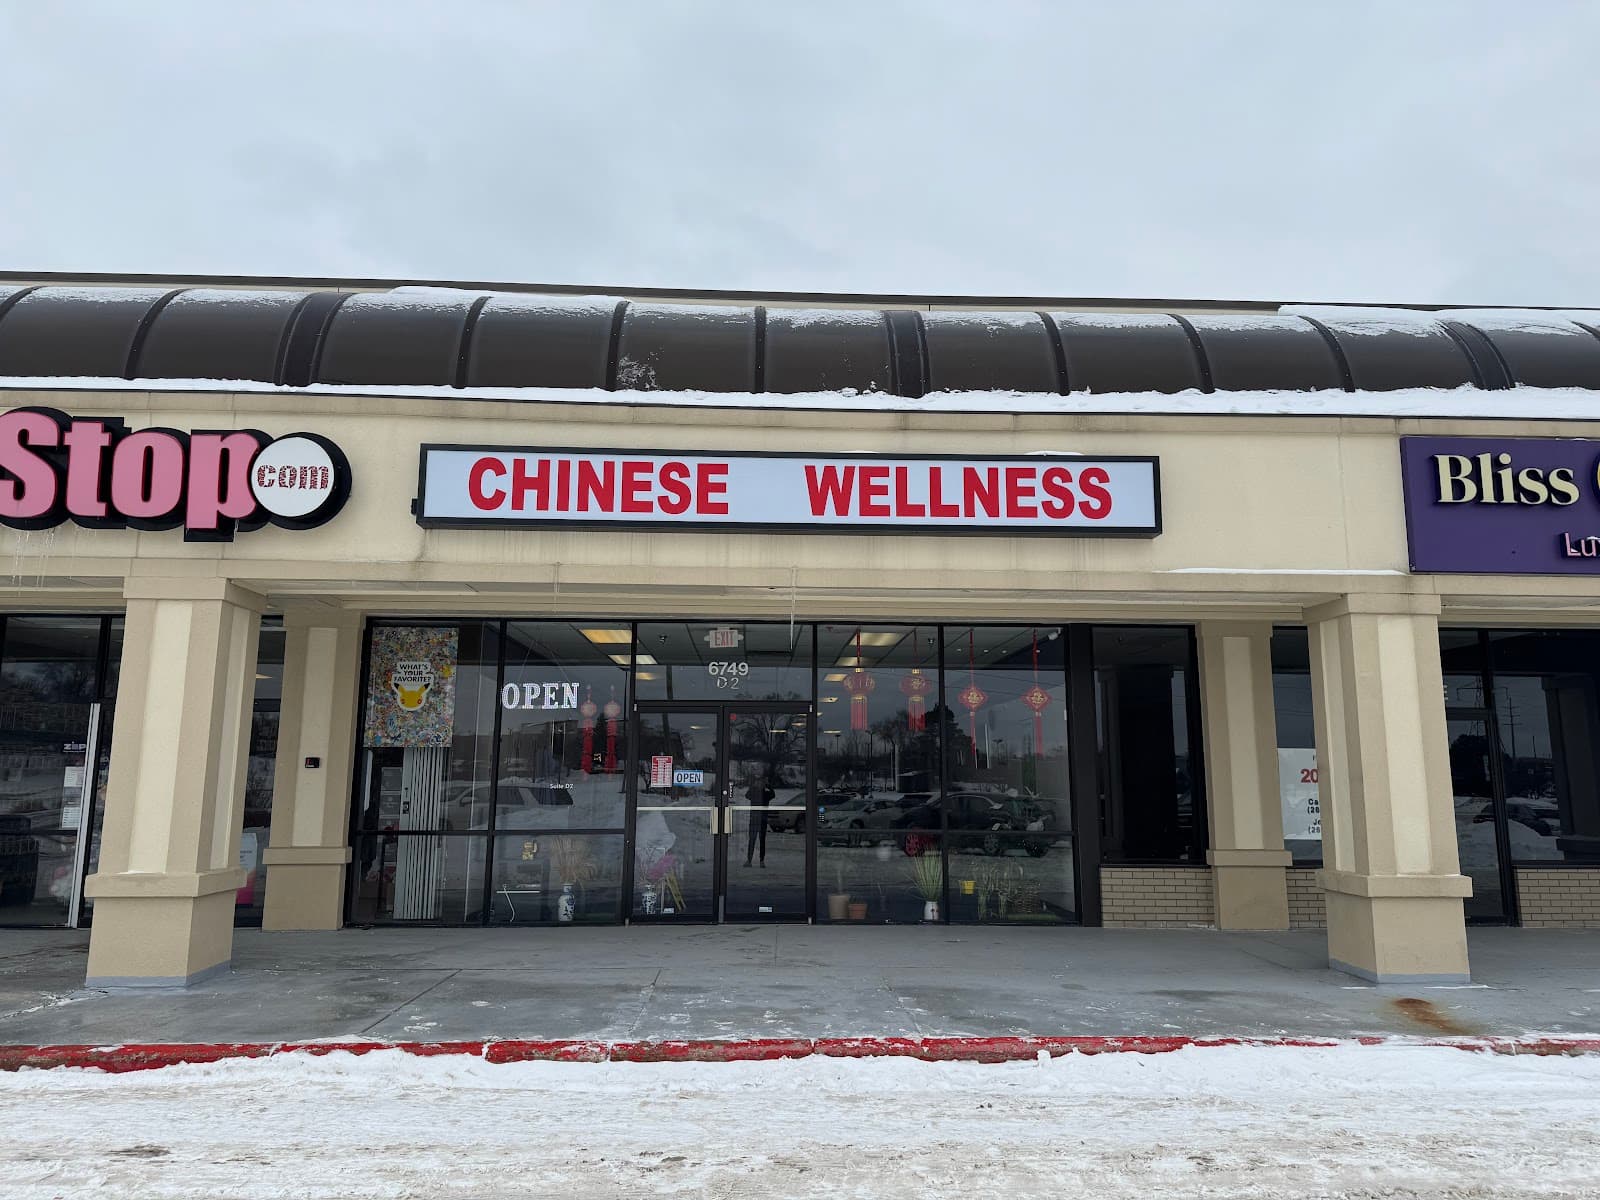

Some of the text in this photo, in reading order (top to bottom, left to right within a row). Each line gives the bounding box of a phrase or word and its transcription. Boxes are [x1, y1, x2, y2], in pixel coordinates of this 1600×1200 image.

[0, 411, 260, 529] Stop
[257, 464, 330, 490] com
[1433, 452, 1581, 506] Bliss
[468, 456, 1112, 520] CHINESE WELLNESS
[714, 631, 735, 646] EXIT
[708, 661, 749, 676] 6749
[501, 682, 580, 710] OPEN
[676, 773, 701, 783] OPEN
